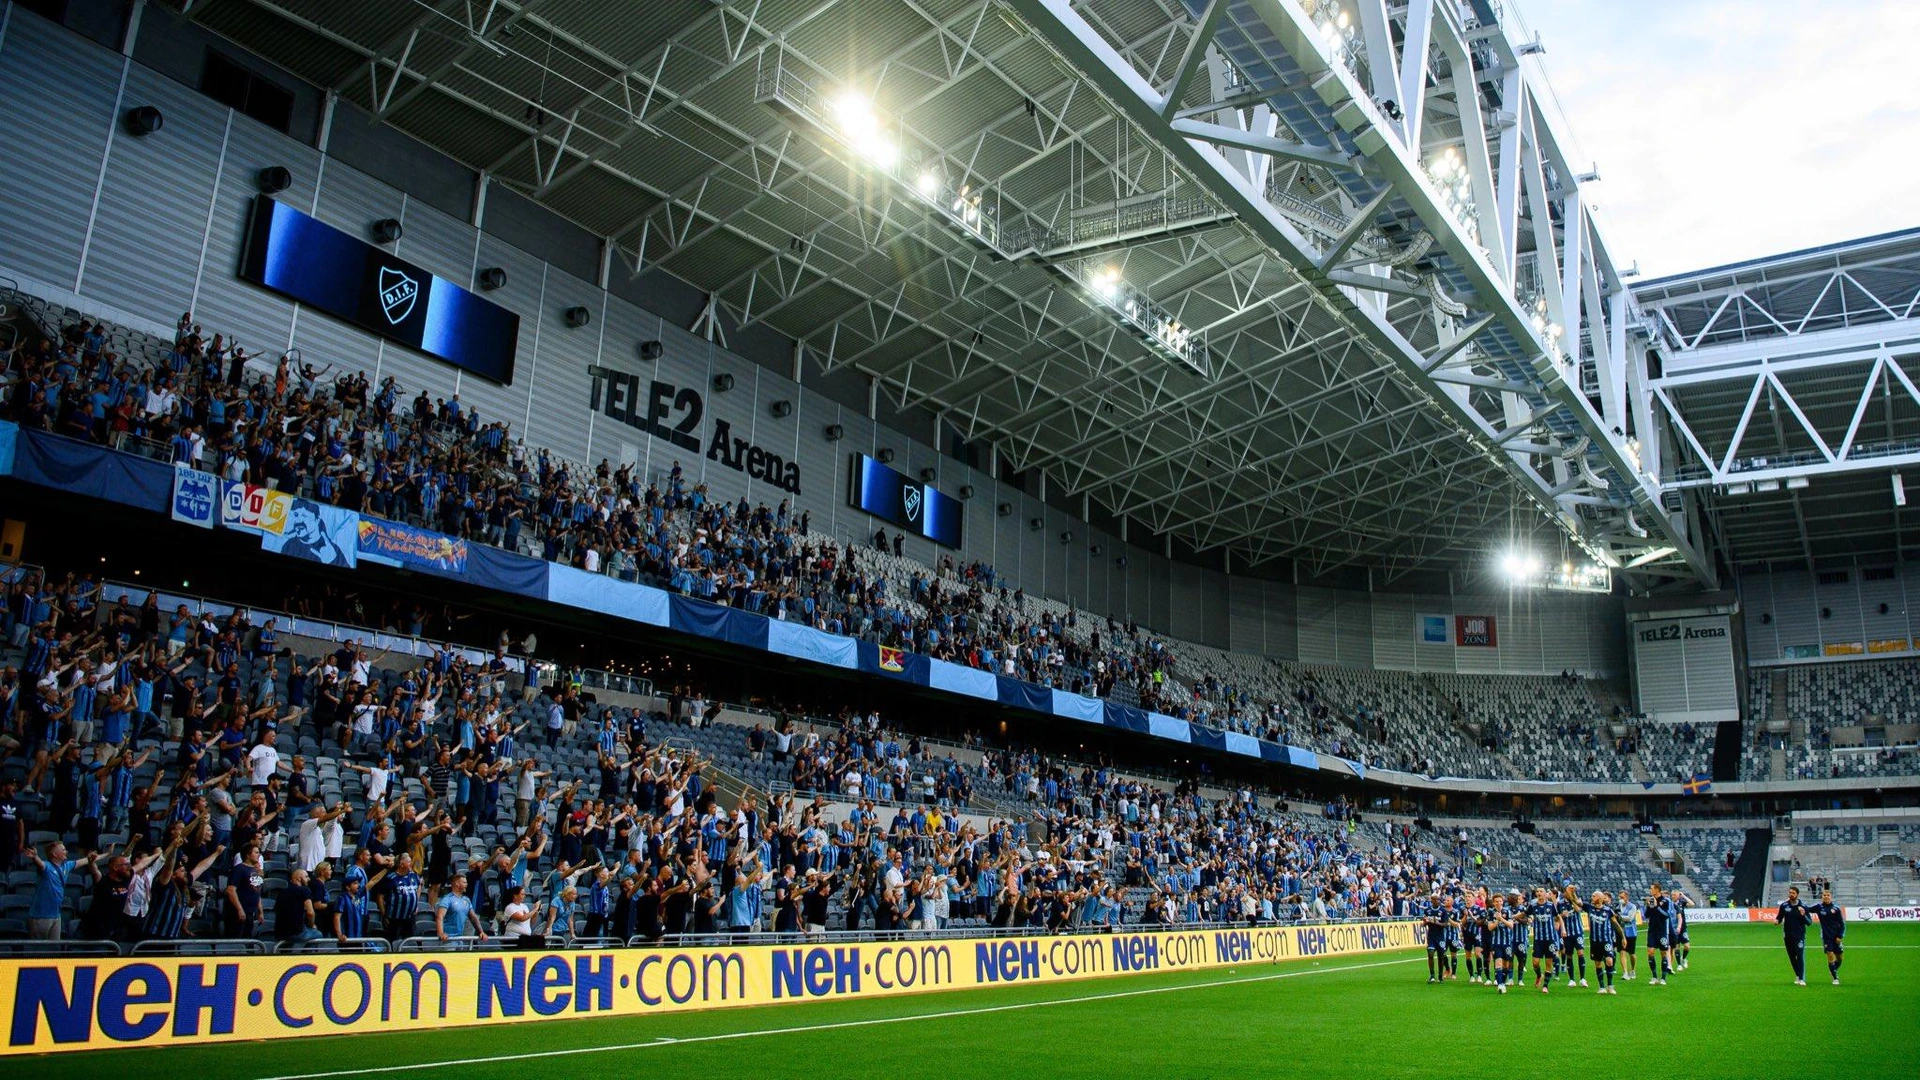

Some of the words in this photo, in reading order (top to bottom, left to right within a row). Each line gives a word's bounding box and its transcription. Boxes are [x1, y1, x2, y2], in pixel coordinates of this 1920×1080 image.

[385, 283, 414, 305] D.I.F.
[588, 364, 703, 454] TELE2
[706, 418, 802, 496] Arena
[1464, 619, 1485, 634] JOB
[1640, 624, 1681, 642] TELE2
[1683, 627, 1725, 639] Arena
[1464, 635, 1489, 644] ZONE
[1736, 912, 1747, 920] AB
